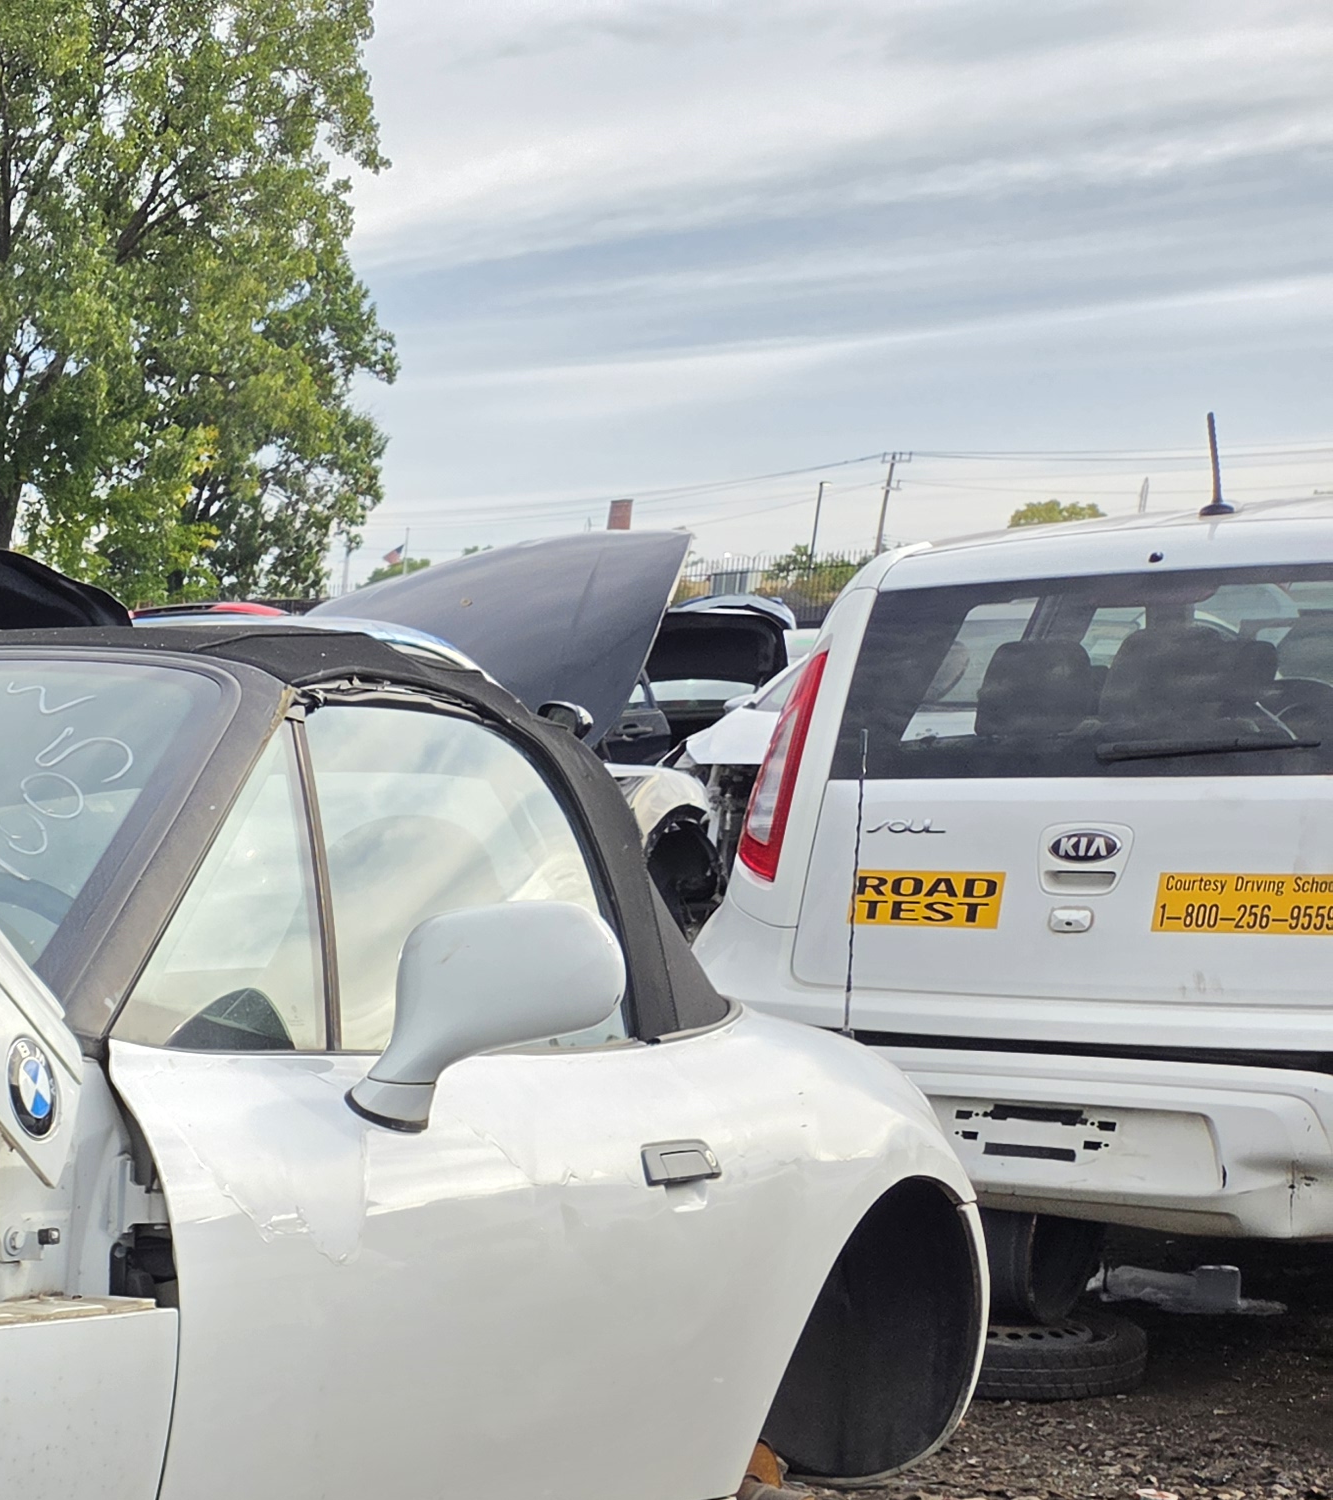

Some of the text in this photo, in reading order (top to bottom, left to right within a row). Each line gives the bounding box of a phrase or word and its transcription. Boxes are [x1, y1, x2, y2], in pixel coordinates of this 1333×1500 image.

[1058, 836, 1109, 857] KIA
[856, 875, 998, 899] ROAD
[1165, 875, 1228, 895] Courtesy
[1234, 876, 1286, 897] Driving
[858, 899, 990, 924] TEST
